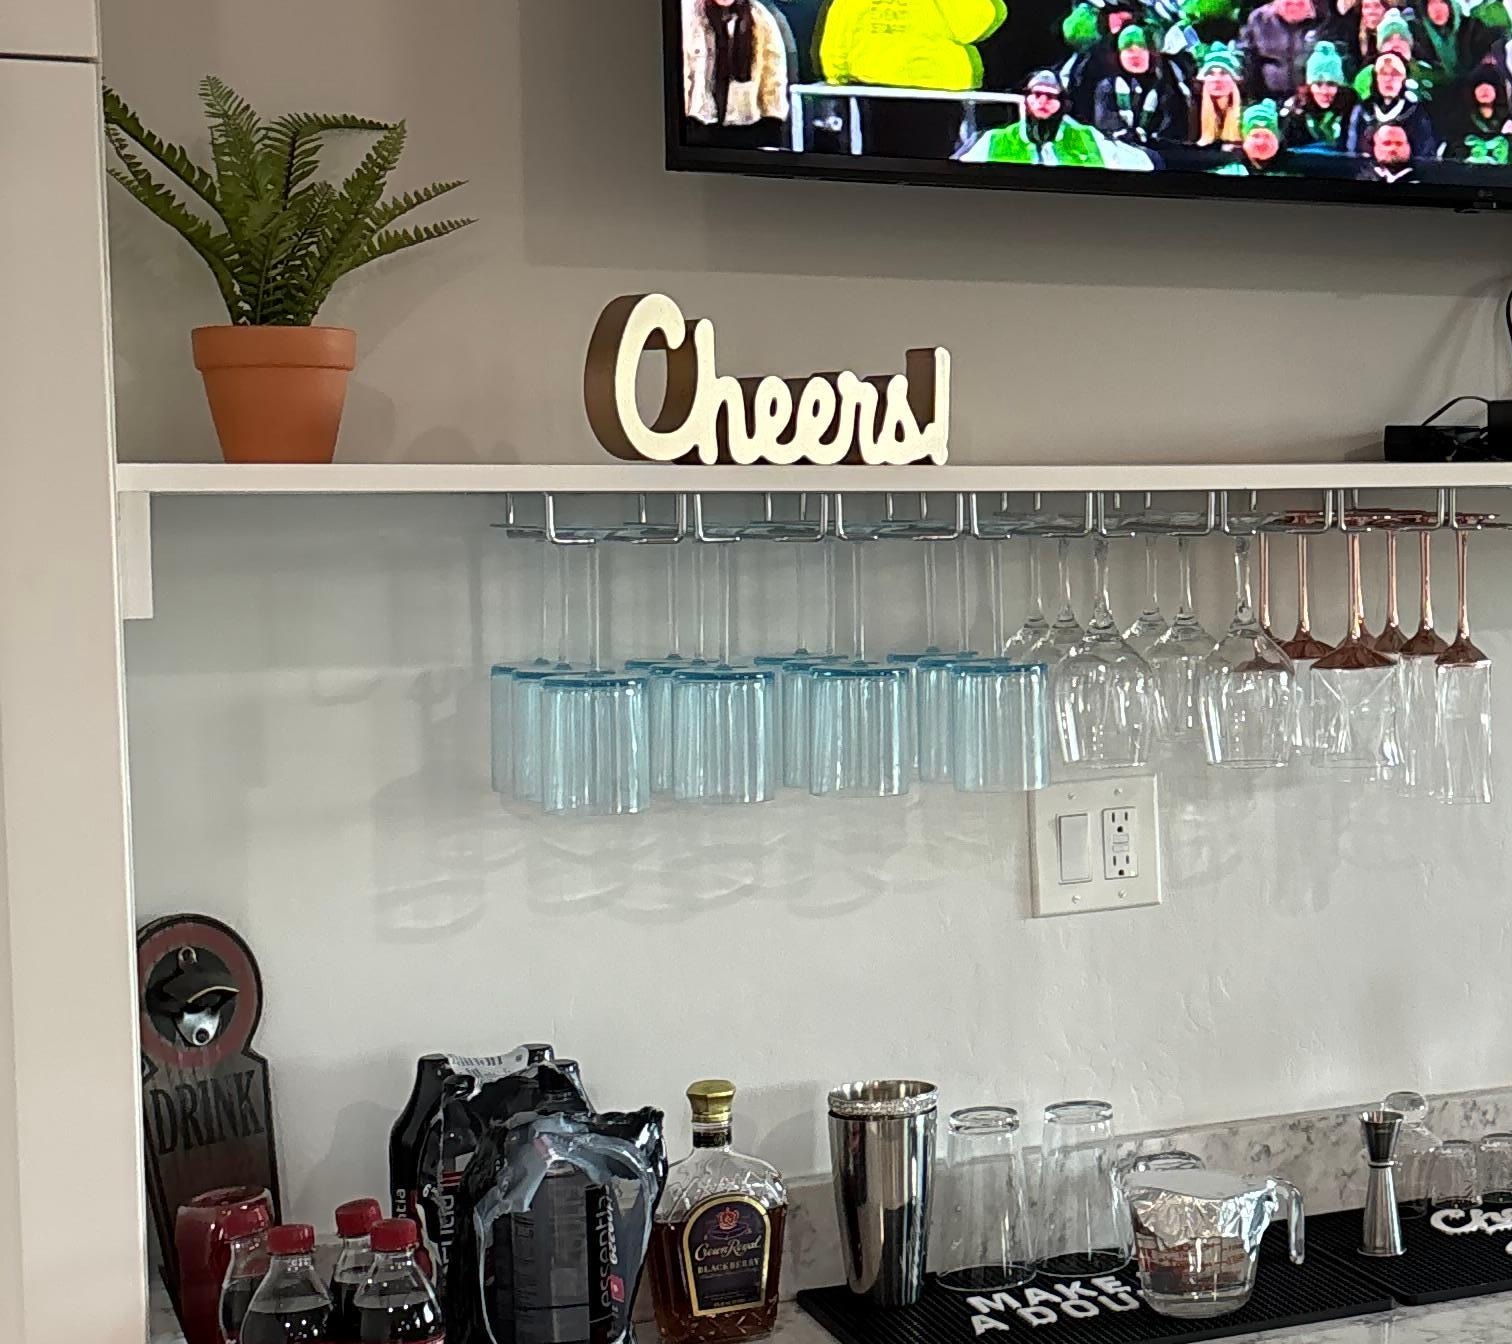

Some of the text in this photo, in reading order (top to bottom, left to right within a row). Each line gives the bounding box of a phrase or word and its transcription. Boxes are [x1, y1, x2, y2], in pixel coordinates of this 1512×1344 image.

[149, 1069, 265, 1155] DRINK
[694, 1235, 762, 1262] Crown Royal
[966, 1275, 1132, 1314] MAKE
[970, 1292, 1143, 1336] A DOU
